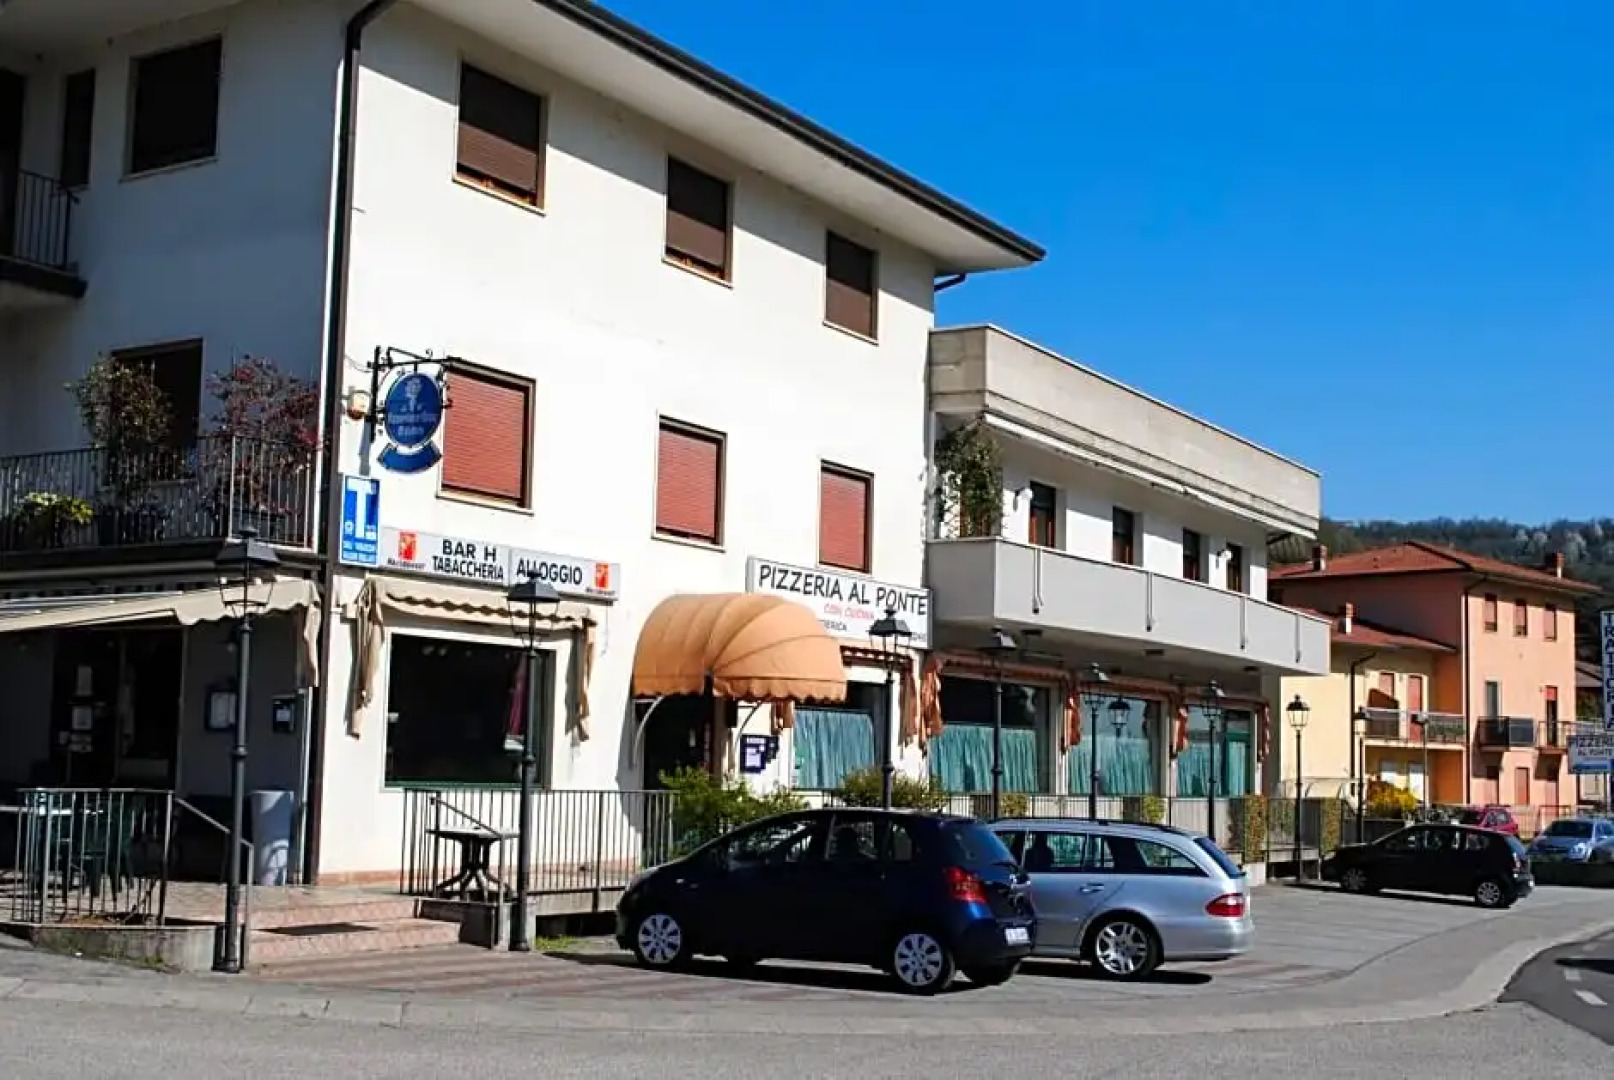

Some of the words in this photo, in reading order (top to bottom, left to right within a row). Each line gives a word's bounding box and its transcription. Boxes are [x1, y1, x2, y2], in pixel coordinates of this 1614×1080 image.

[347, 478, 377, 538] T
[442, 538, 476, 559] BAR
[484, 545, 497, 562] H
[432, 555, 504, 580] TABACCHERIA
[516, 557, 583, 585] ALLOGGIO
[758, 564, 843, 601] PIZZERIA
[847, 583, 870, 605] AL
[875, 586, 927, 616] PONTE
[1569, 736, 1614, 748] PIZZERI
